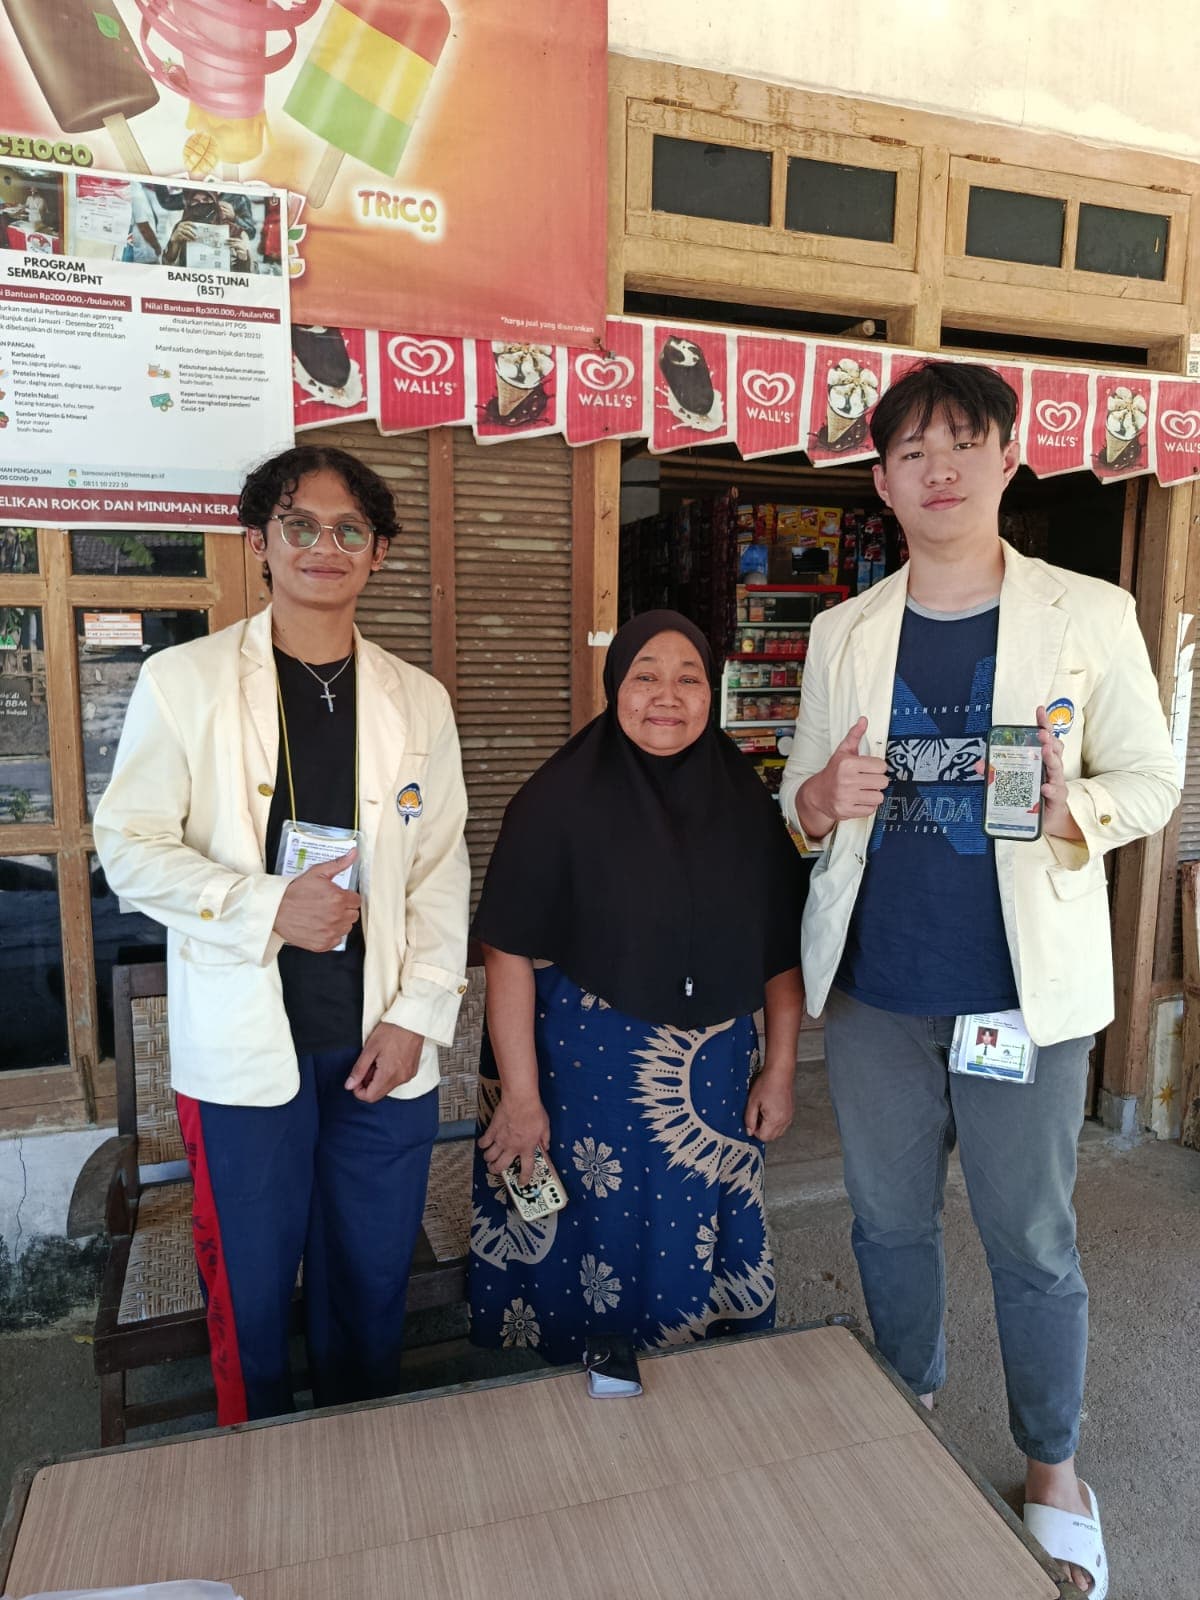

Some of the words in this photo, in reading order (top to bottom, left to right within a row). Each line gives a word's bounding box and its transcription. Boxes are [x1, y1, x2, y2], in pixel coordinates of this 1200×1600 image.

[24, 257, 86, 272] PROGRAM
[7, 267, 103, 285] SEMBAKO/BPNT
[167, 271, 214, 284] BANSOS
[216, 276, 249, 288] TUNAI
[5, 289, 38, 300] Bantuan
[39, 292, 127, 307] Rp200.000,-/bulan/KK
[197, 284, 225, 298] (BST)
[145, 302, 163, 311] Nilai
[164, 303, 195, 313] Bantuan
[21, 307, 44, 315] melalui
[45, 308, 79, 318] Perbankan
[79, 311, 91, 319] dan
[92, 314, 106, 322] agen
[107, 315, 123, 323] yang
[24, 316, 36, 324] dari
[38, 317, 61, 326] Januari
[65, 319, 97, 328] Desember
[98, 321, 114, 330] 2021
[172, 317, 203, 327] disalurkan
[204, 320, 225, 328] melalui
[234, 322, 247, 330] POS
[525, 320, 539, 328] jual
[539, 322, 556, 331] yang
[557, 323, 595, 333] disarankan
[5, 323, 45, 334] dibelanjakan
[53, 328, 76, 337] tempat
[77, 329, 91, 338] yang
[93, 331, 126, 340] ditentukan
[185, 327, 202, 335] bulan
[11, 351, 45, 359] Karbohidrat
[155, 344, 193, 353] Manfaatkan
[194, 347, 217, 356] dengan
[218, 348, 233, 357] bijak
[37, 371, 60, 379] Hewani
[394, 377, 453, 396] WALL'S
[14, 390, 38, 398] Protein
[38, 391, 59, 400] Nabati
[578, 392, 633, 409] WALL'S
[66, 413, 88, 421] Mineral
[746, 406, 791, 424] WALL'S
[1036, 433, 1076, 448] WALL'S
[13, 467, 52, 475] PENGADUAN
[51, 498, 101, 511] ROKOK
[104, 499, 134, 511] DAN
[137, 501, 202, 514] MINUMAN
[204, 503, 240, 515] KERA
